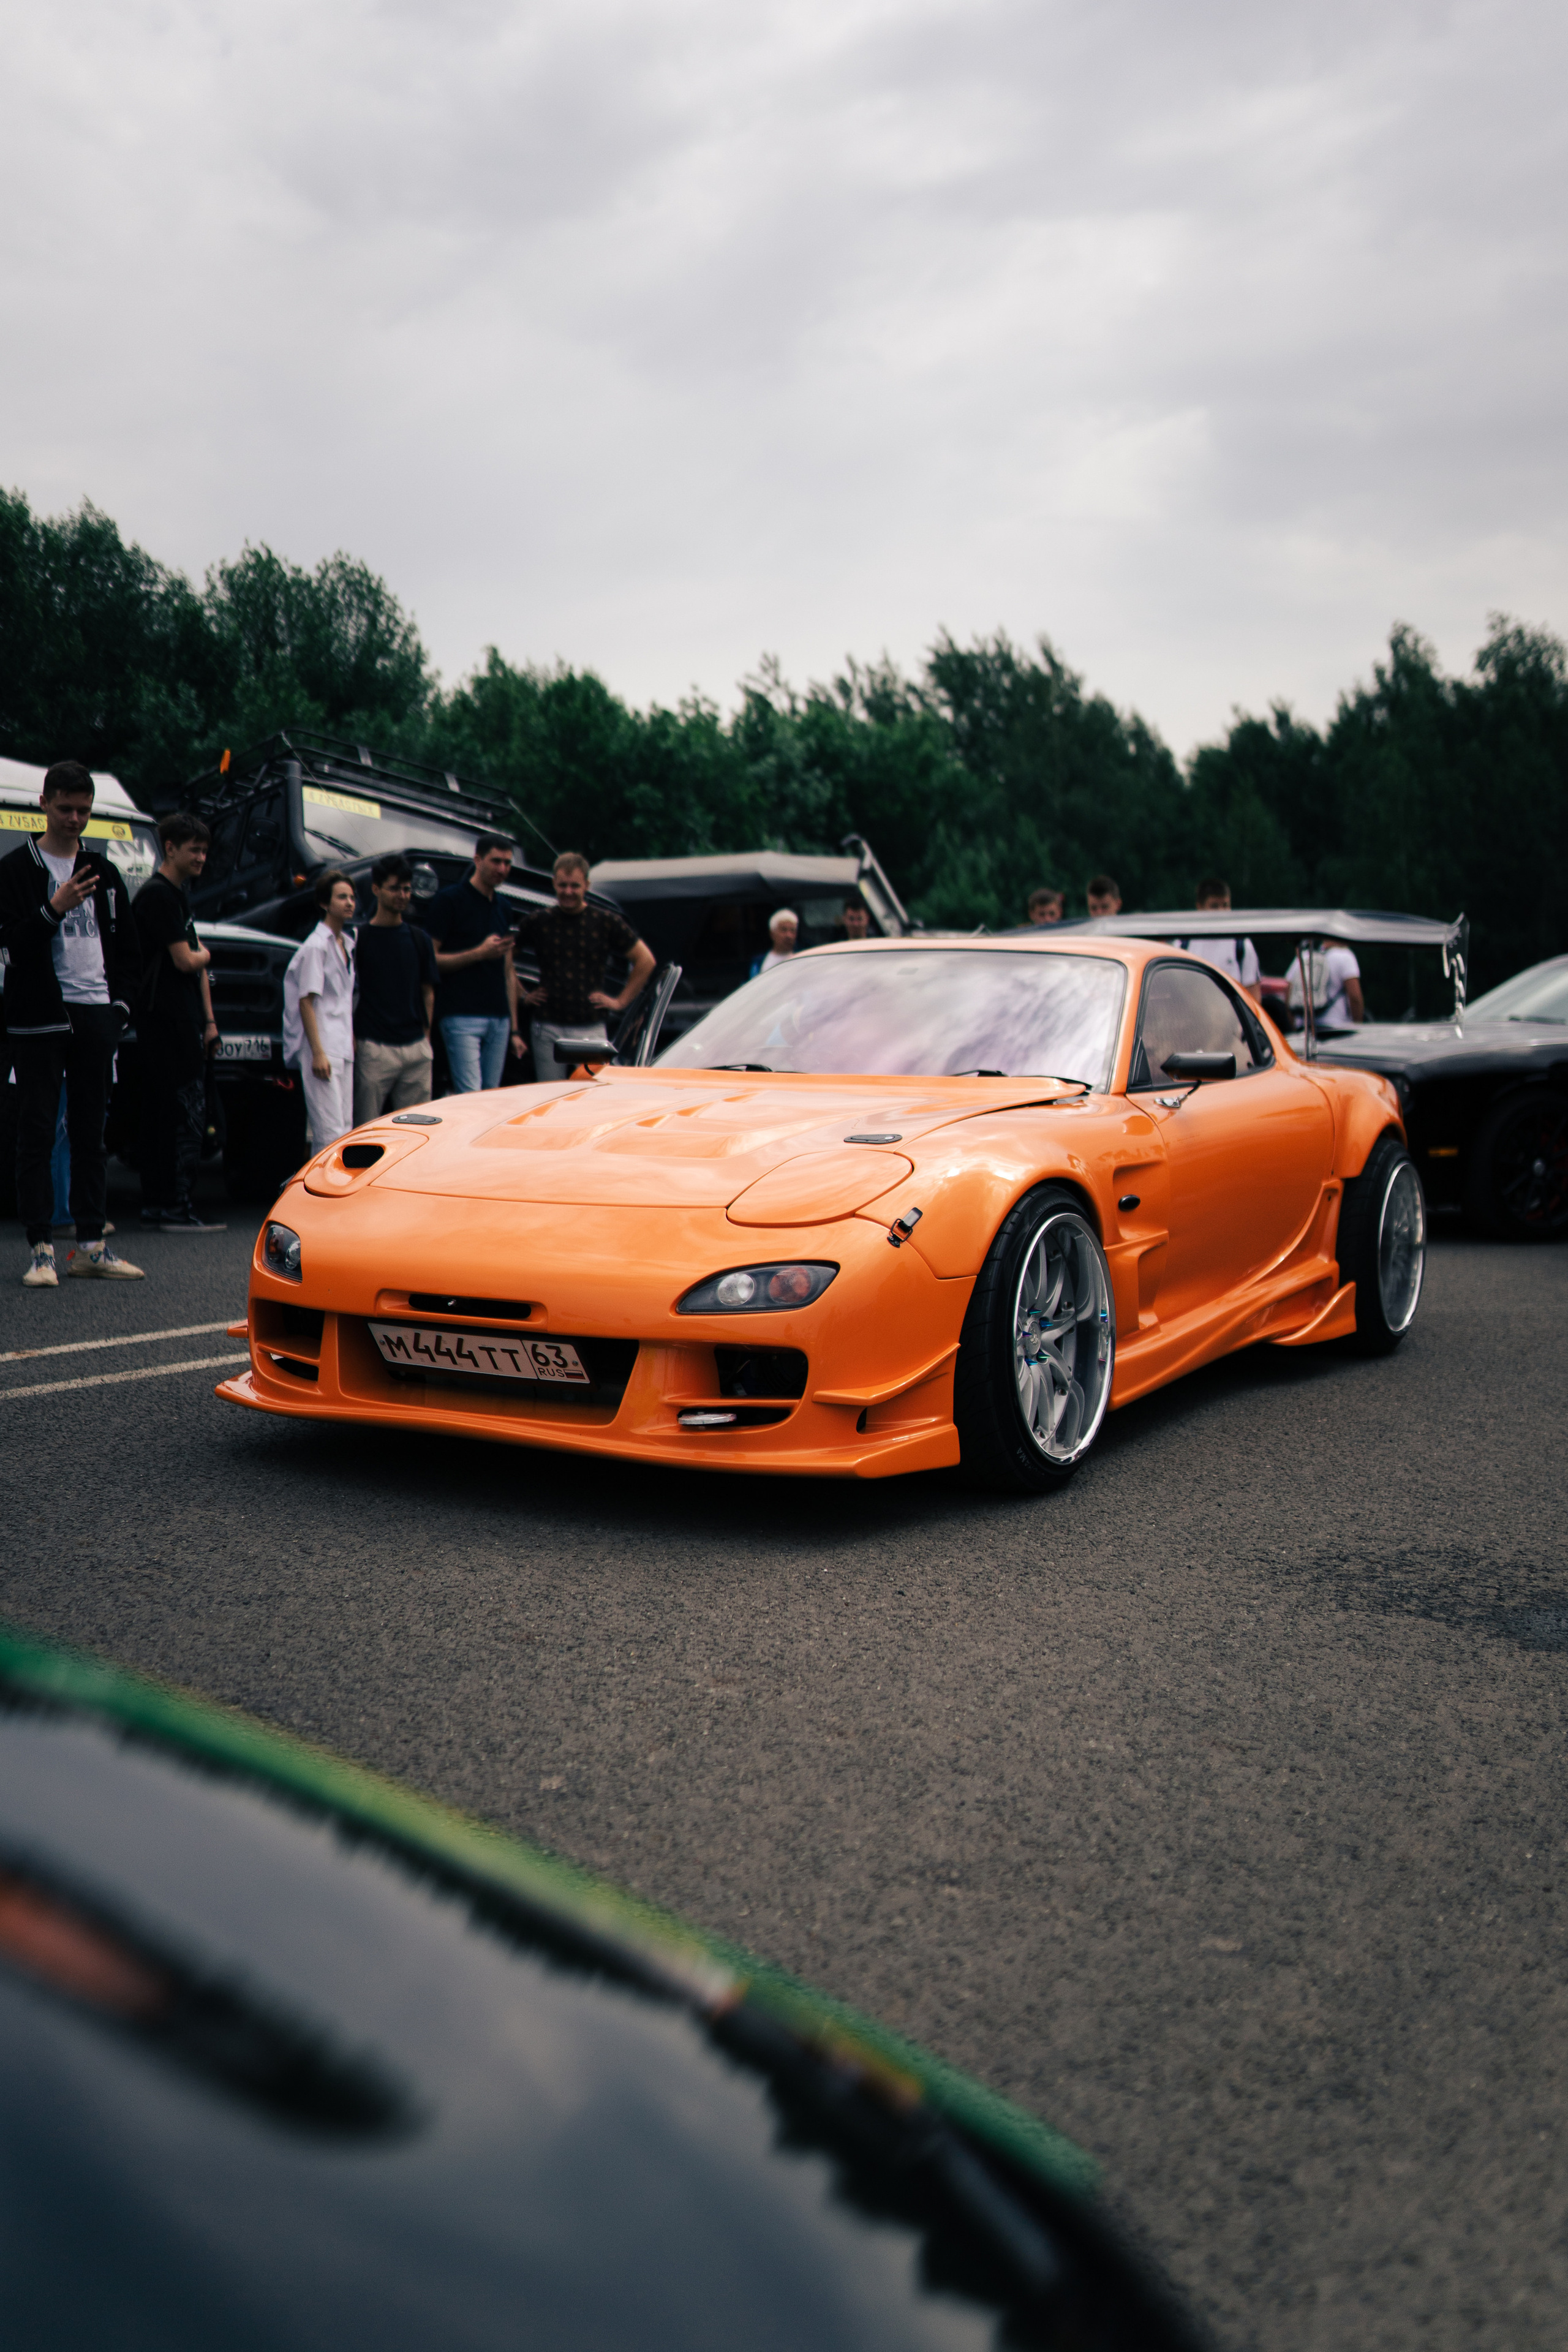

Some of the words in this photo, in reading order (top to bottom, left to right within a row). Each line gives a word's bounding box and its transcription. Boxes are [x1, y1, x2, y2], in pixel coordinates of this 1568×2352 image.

[382, 1332, 521, 1372] M444TT
[531, 1343, 568, 1368] 63
[538, 1367, 565, 1378] RUS
